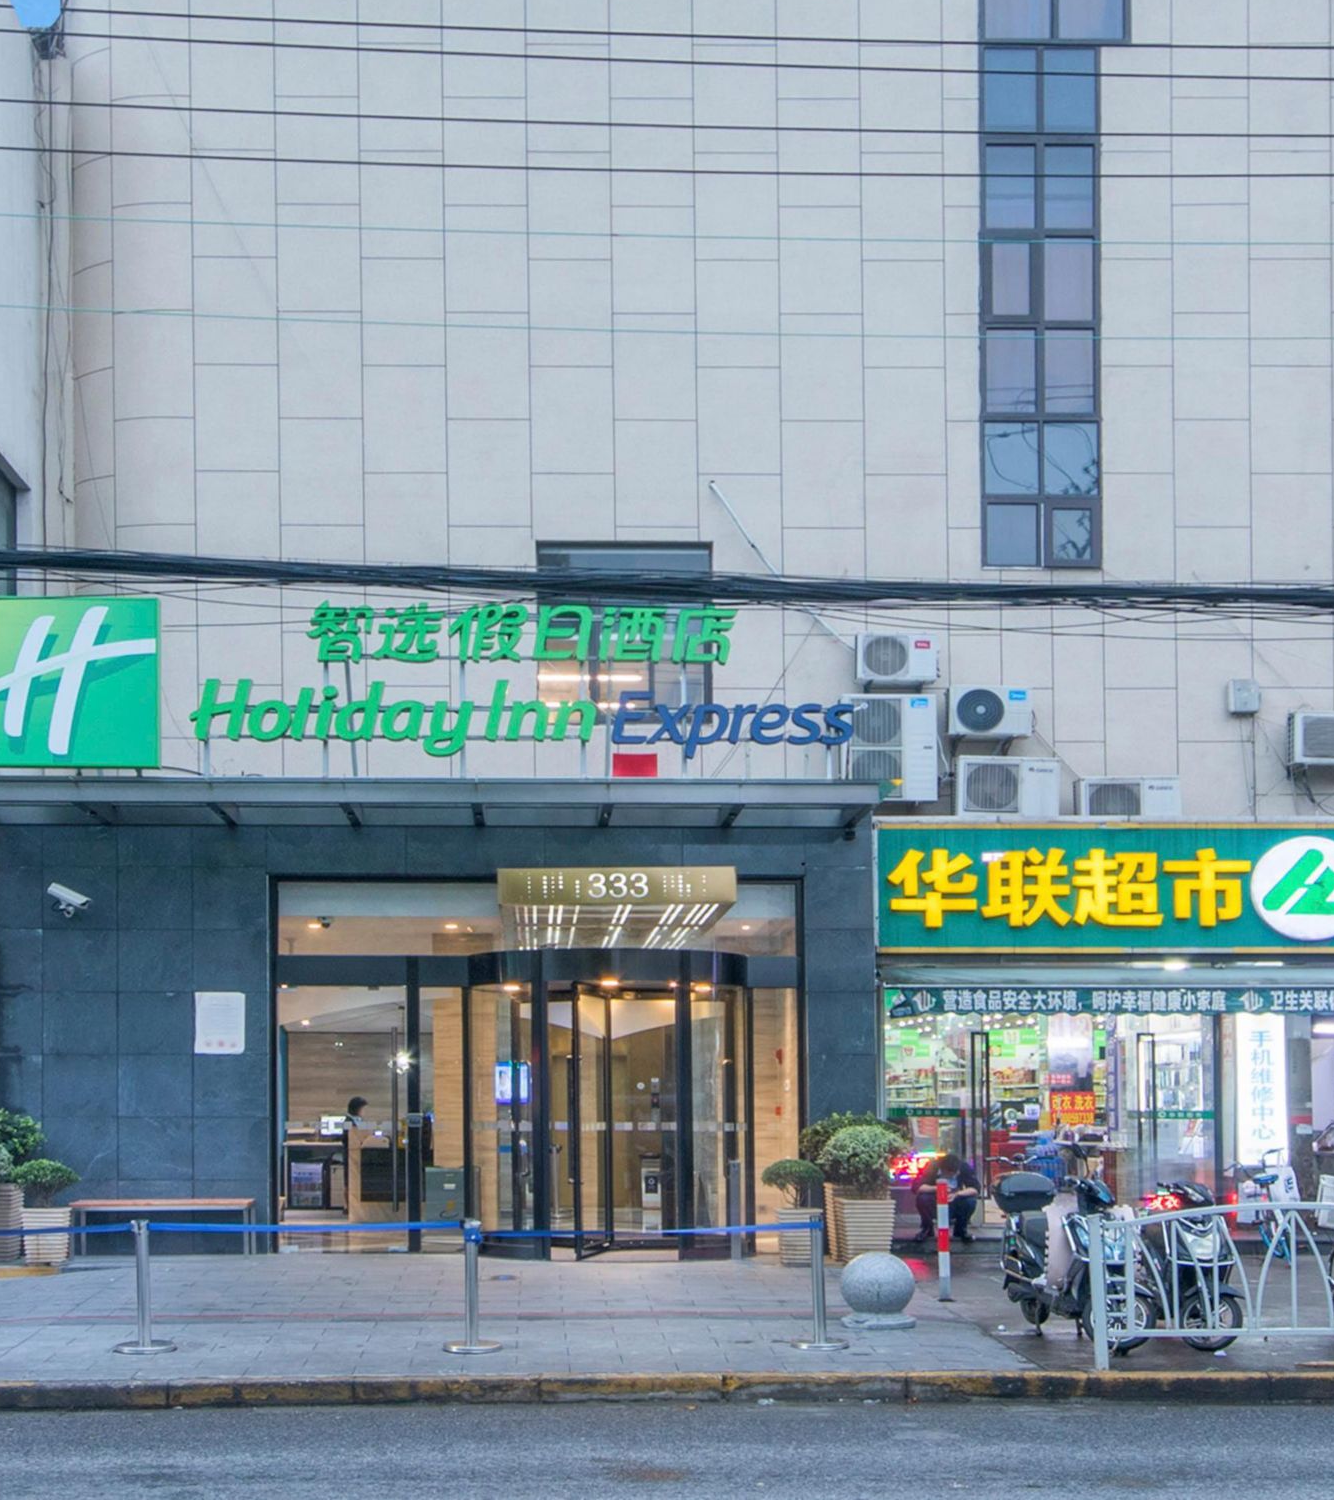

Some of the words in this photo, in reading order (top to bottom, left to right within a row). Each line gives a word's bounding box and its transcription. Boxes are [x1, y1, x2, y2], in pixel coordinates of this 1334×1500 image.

[306, 601, 739, 665] 智选假日酒店
[189, 678, 475, 758] Holiday
[484, 678, 598, 743] Inn
[611, 690, 856, 761] Express
[587, 872, 649, 899] 333
[887, 847, 1251, 929] 华联超市
[1249, 1030, 1276, 1140] 手机维修中心
